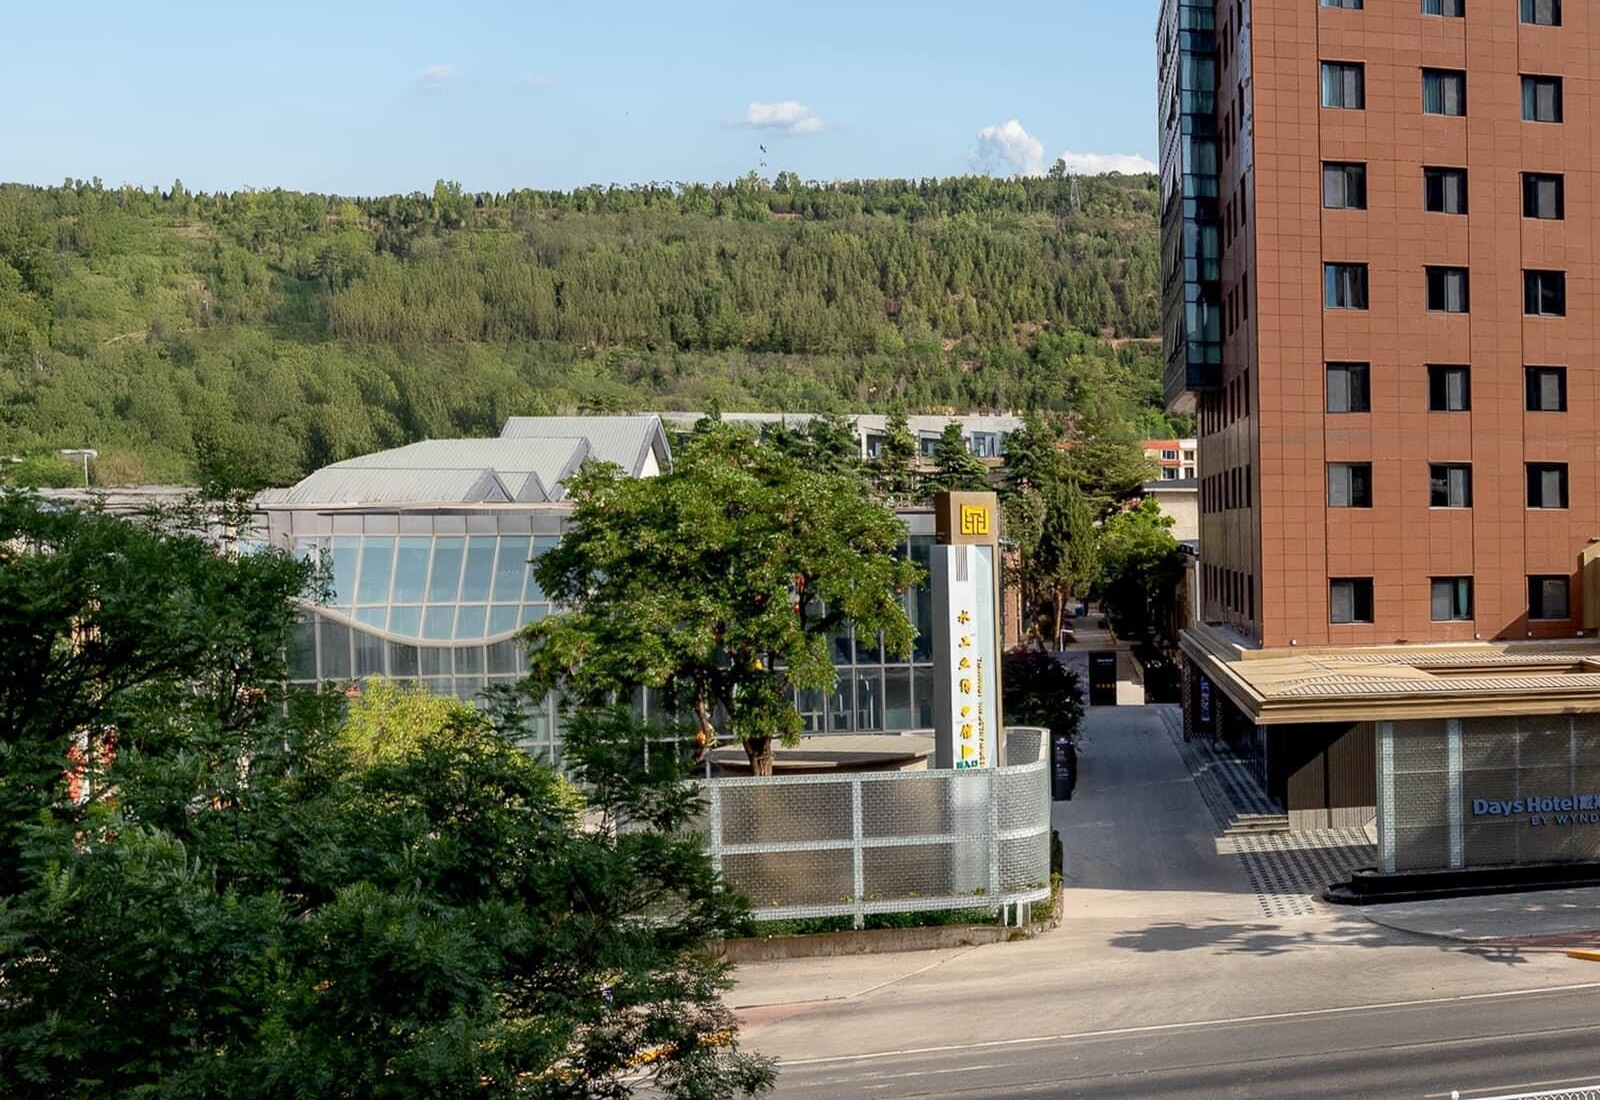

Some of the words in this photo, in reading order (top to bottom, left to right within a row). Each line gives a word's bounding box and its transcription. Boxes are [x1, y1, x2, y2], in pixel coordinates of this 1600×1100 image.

[1472, 797, 1524, 817] Days
[1526, 794, 1578, 814] Hotel
[1530, 815, 1549, 826] BY
